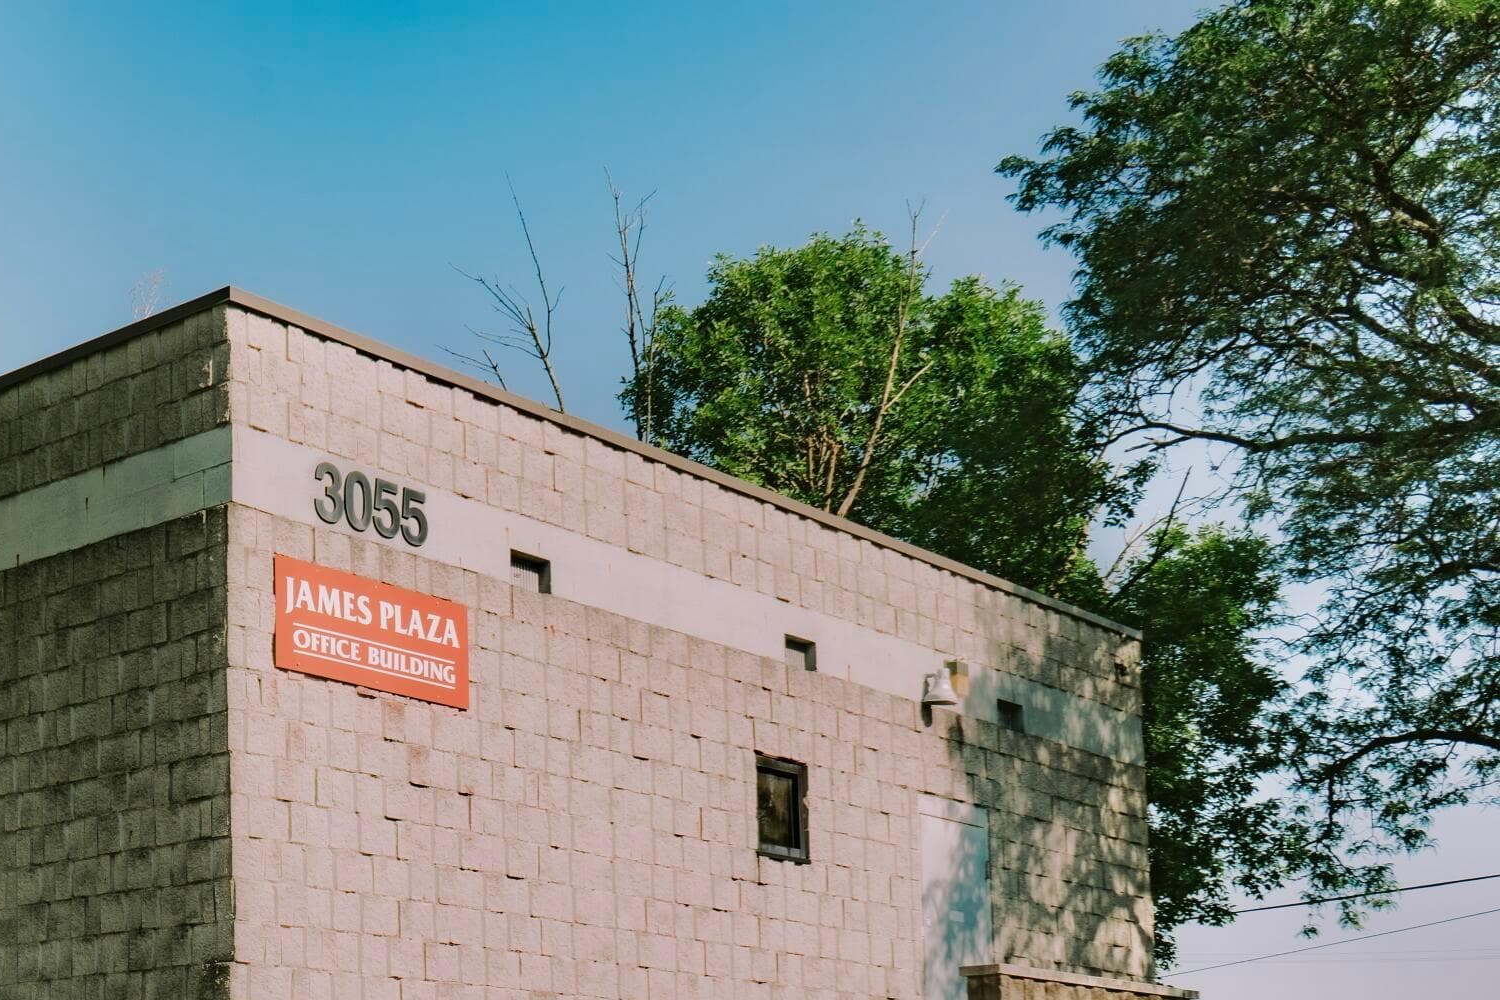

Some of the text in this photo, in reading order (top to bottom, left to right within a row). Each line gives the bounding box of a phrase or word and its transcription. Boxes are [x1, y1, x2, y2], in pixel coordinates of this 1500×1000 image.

[314, 462, 428, 547] 3055
[285, 576, 460, 649] JAMES PLAZA
[293, 629, 456, 684] OFFICE BUILDING
